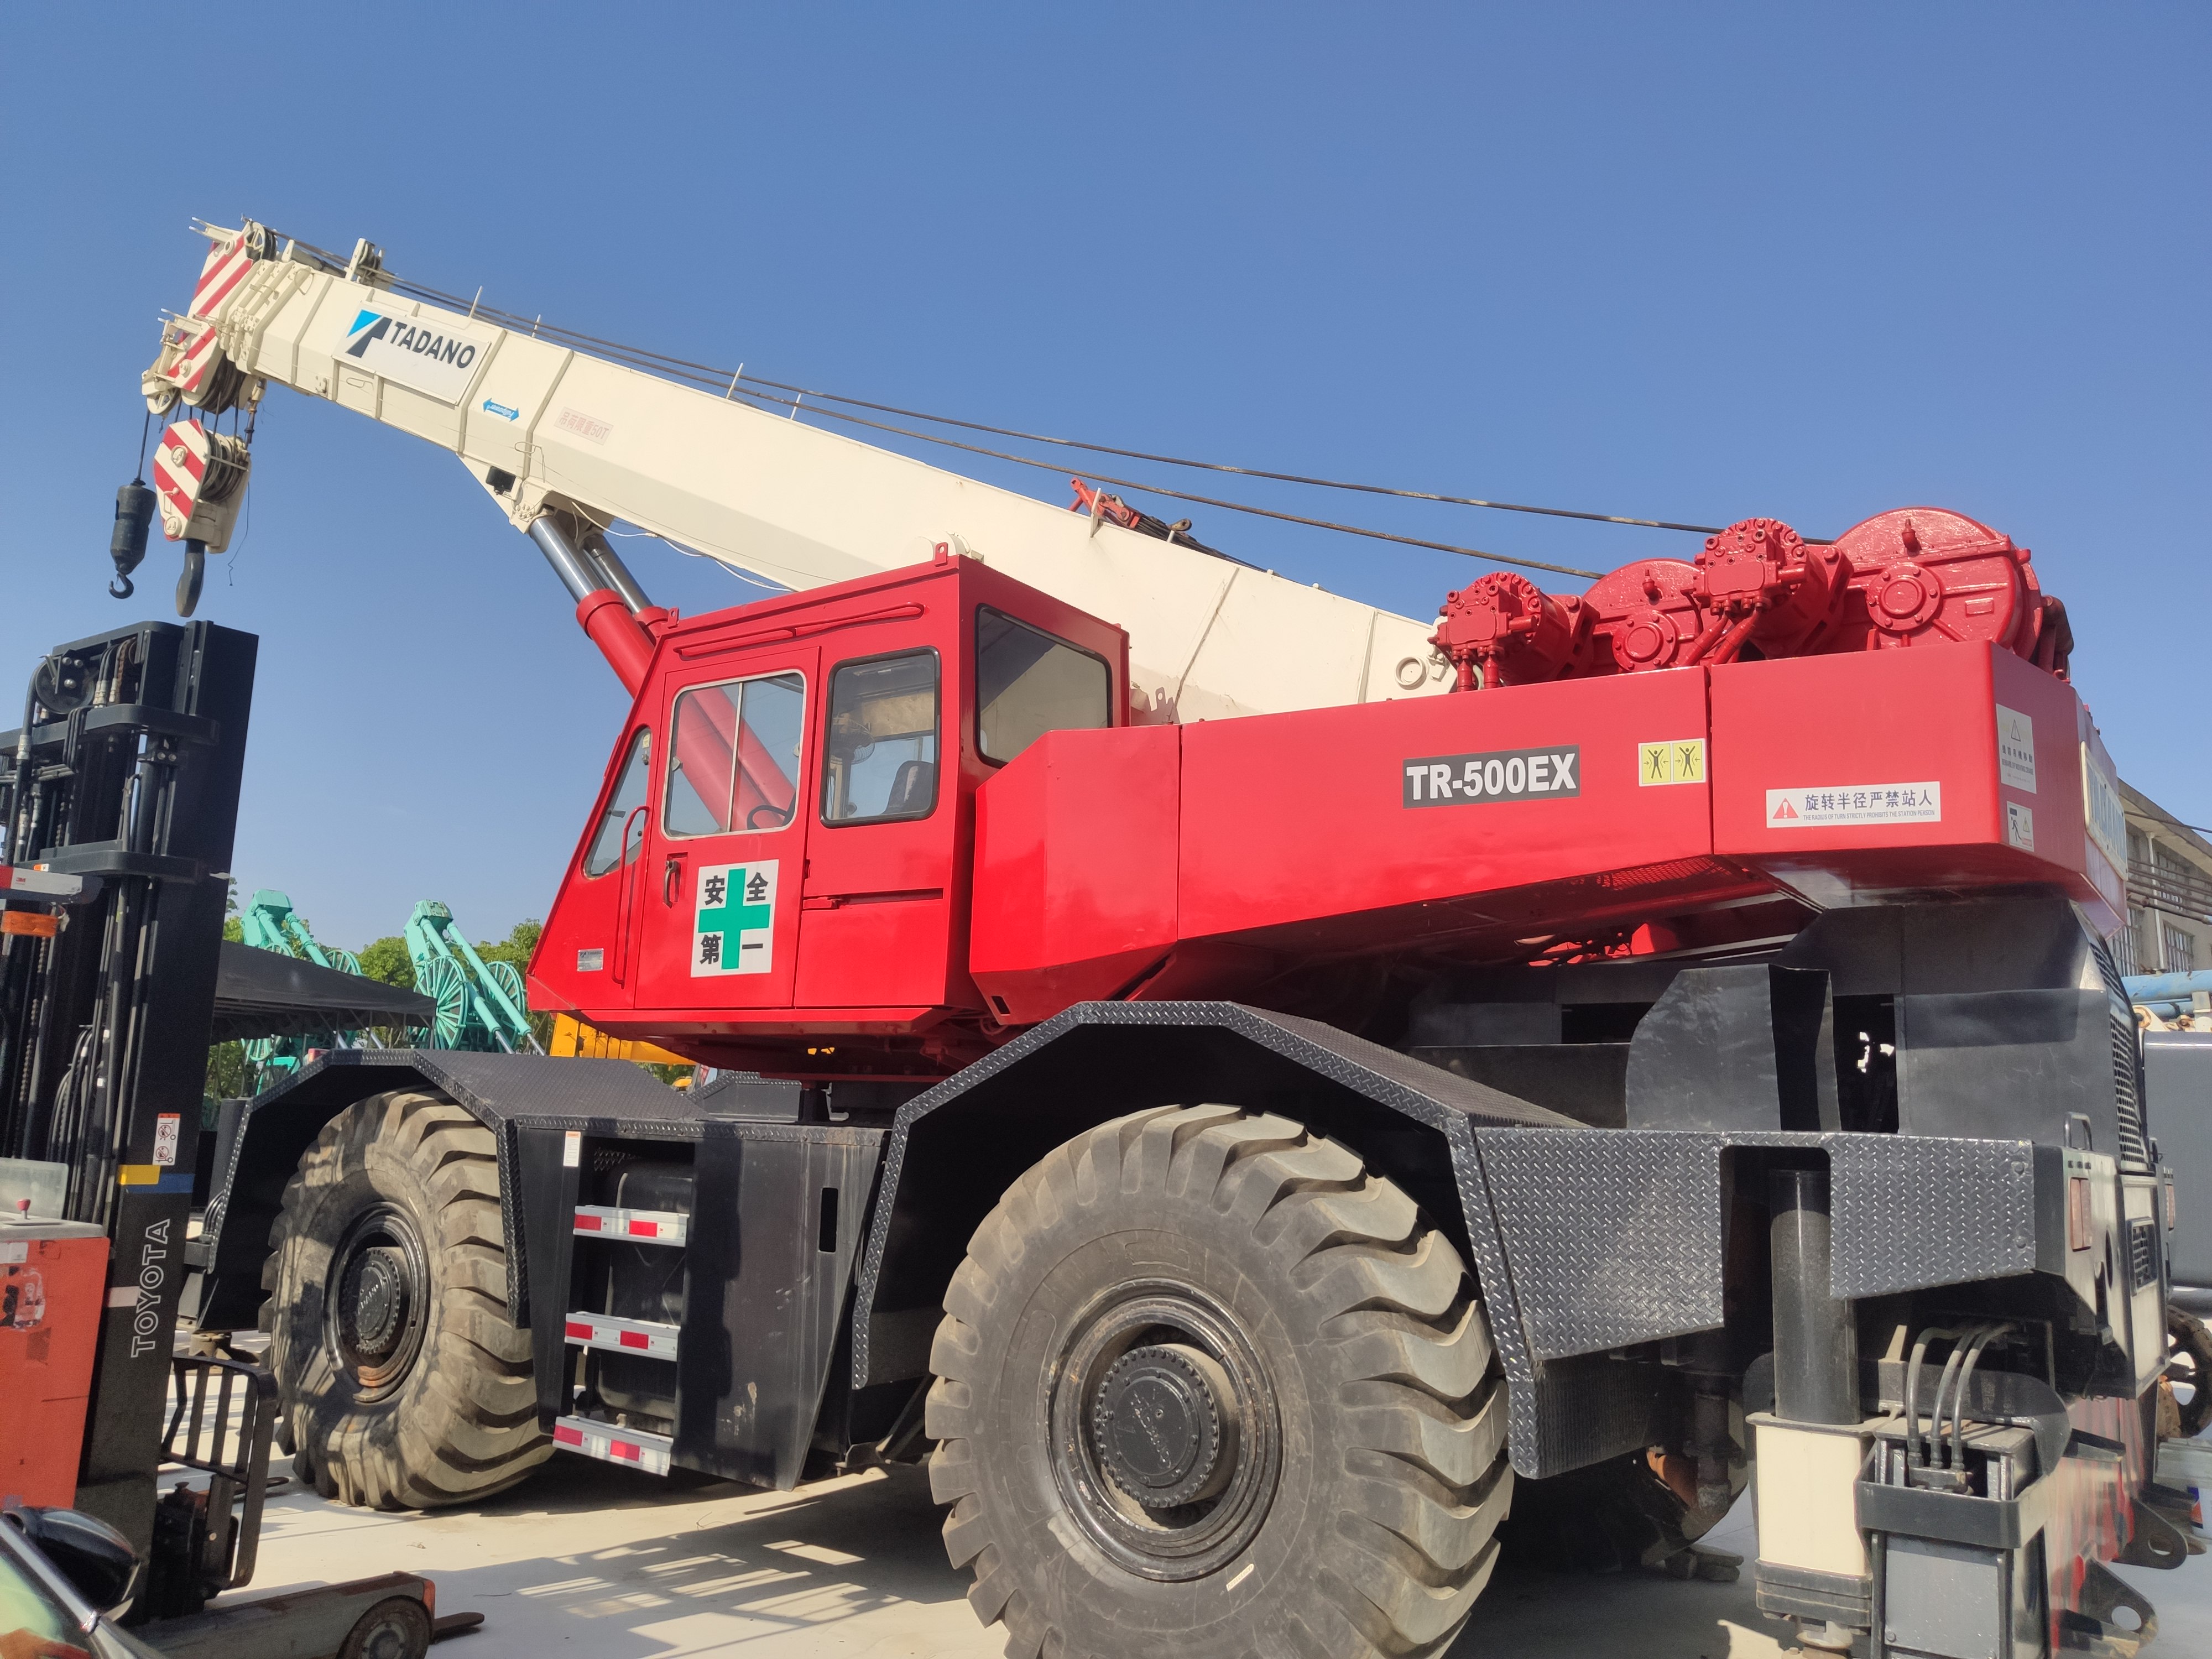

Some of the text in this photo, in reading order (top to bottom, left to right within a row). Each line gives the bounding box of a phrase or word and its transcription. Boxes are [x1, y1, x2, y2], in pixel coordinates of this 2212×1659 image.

[390, 321, 476, 369] TADANO
[1406, 753, 1577, 800] TR-500EX
[1805, 789, 1933, 811] 旋转半径严禁站人
[705, 872, 769, 906] 安全
[700, 934, 763, 964] 第一
[131, 1218, 170, 1358] TOYOTA
